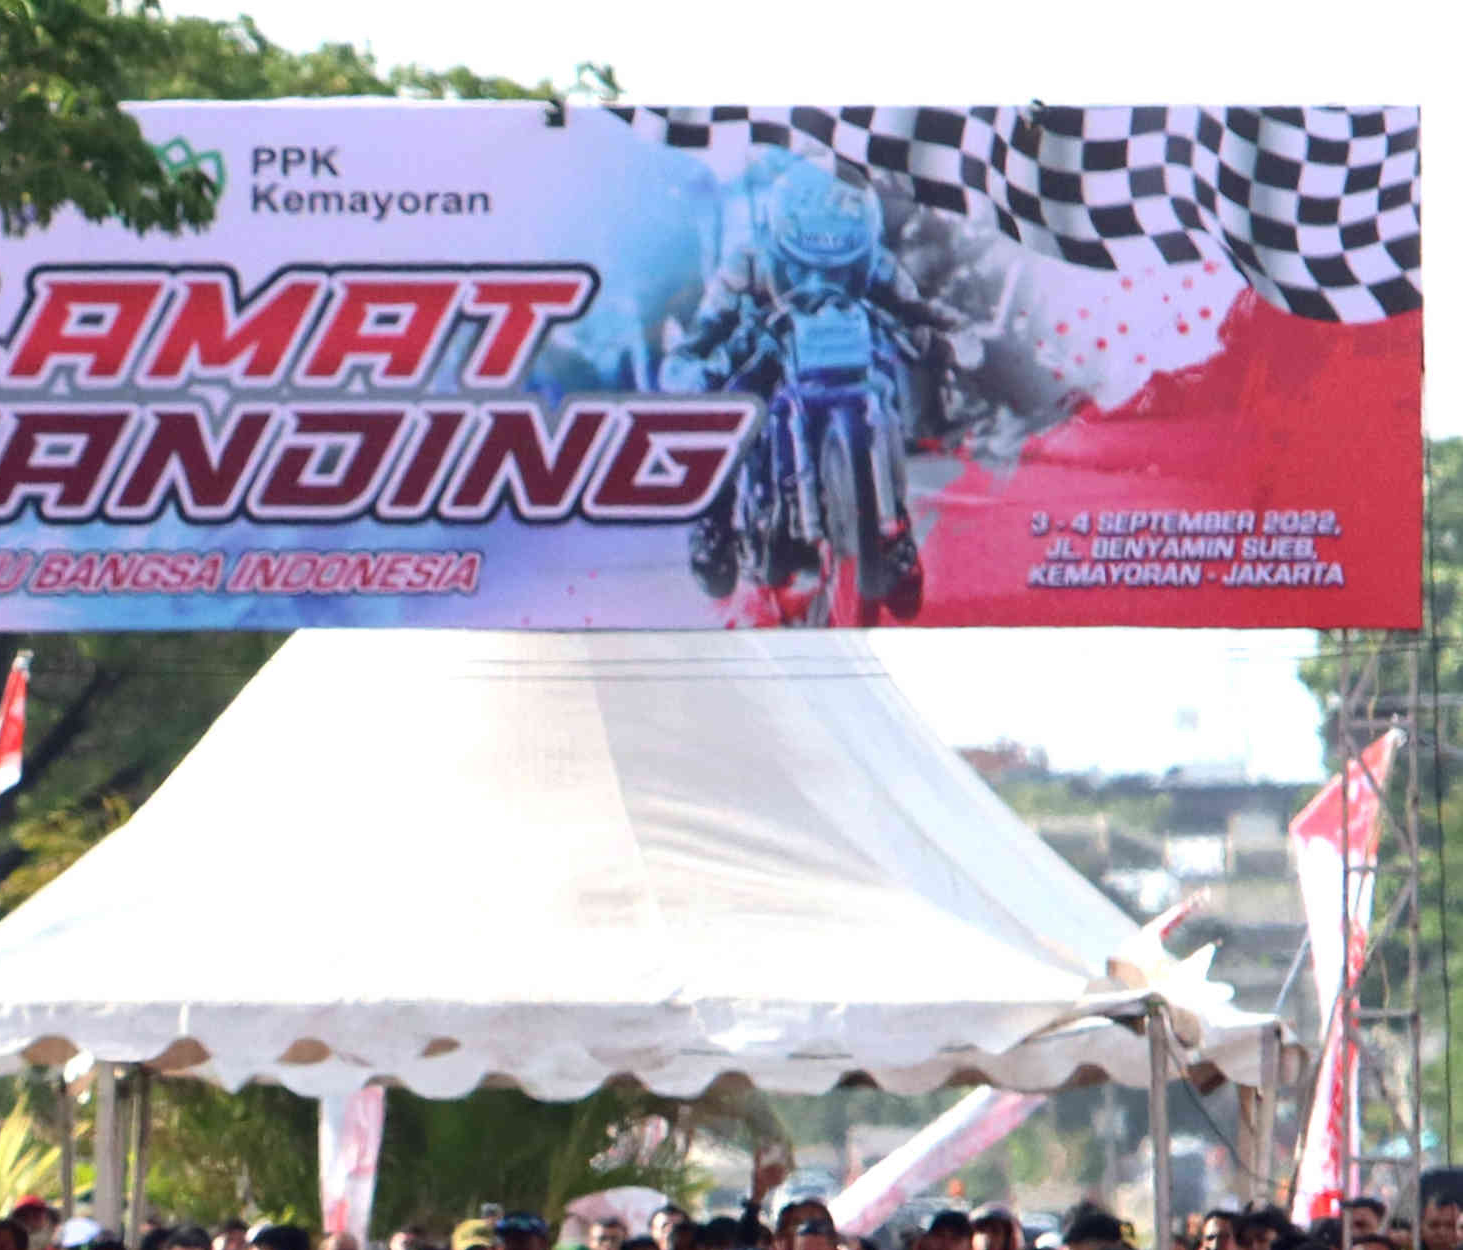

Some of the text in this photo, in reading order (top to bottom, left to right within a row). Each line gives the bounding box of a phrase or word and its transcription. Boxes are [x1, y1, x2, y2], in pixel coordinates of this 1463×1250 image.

[251, 146, 341, 178] PPK
[251, 184, 493, 222] Kemayoran
[1029, 511, 1050, 534] 3
[1070, 511, 1091, 534] 4
[1096, 510, 1257, 535] SEPTEMBER
[1045, 537, 1082, 561] JL.
[1090, 537, 1236, 561] BENYAMIN
[29, 552, 218, 594] BANGSA
[226, 551, 481, 594] INDONESIA
[1027, 562, 1203, 587] KEMAYORAN
[1221, 562, 1345, 587] JAKARTA
